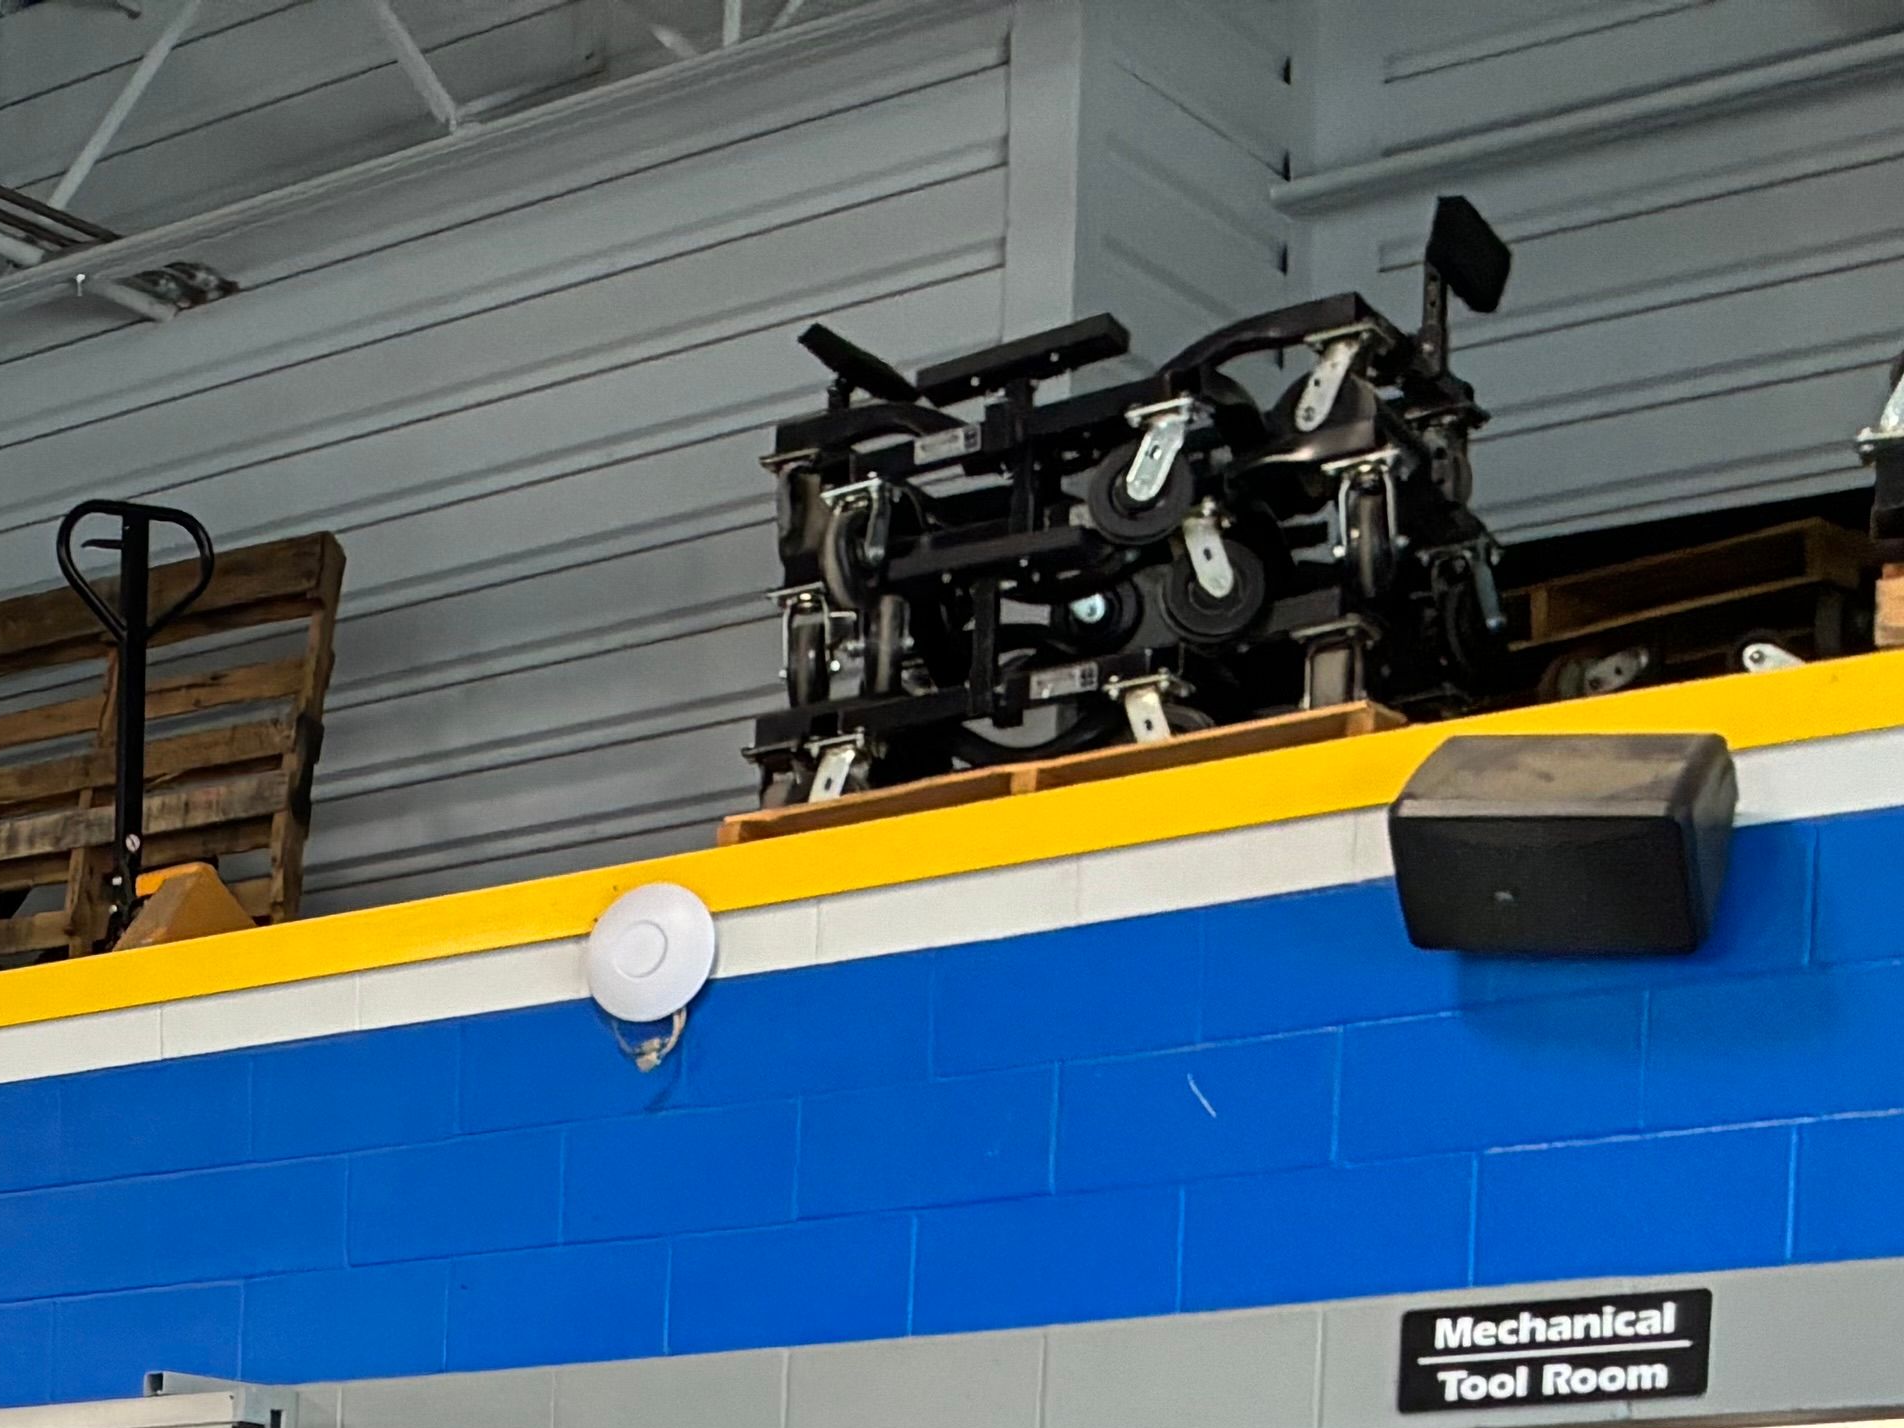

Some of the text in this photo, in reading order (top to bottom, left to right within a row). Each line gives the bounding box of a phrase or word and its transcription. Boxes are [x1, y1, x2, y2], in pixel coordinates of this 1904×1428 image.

[1434, 1301, 1676, 1350] Mechanical
[1437, 1362, 1669, 1402] Tool Room
